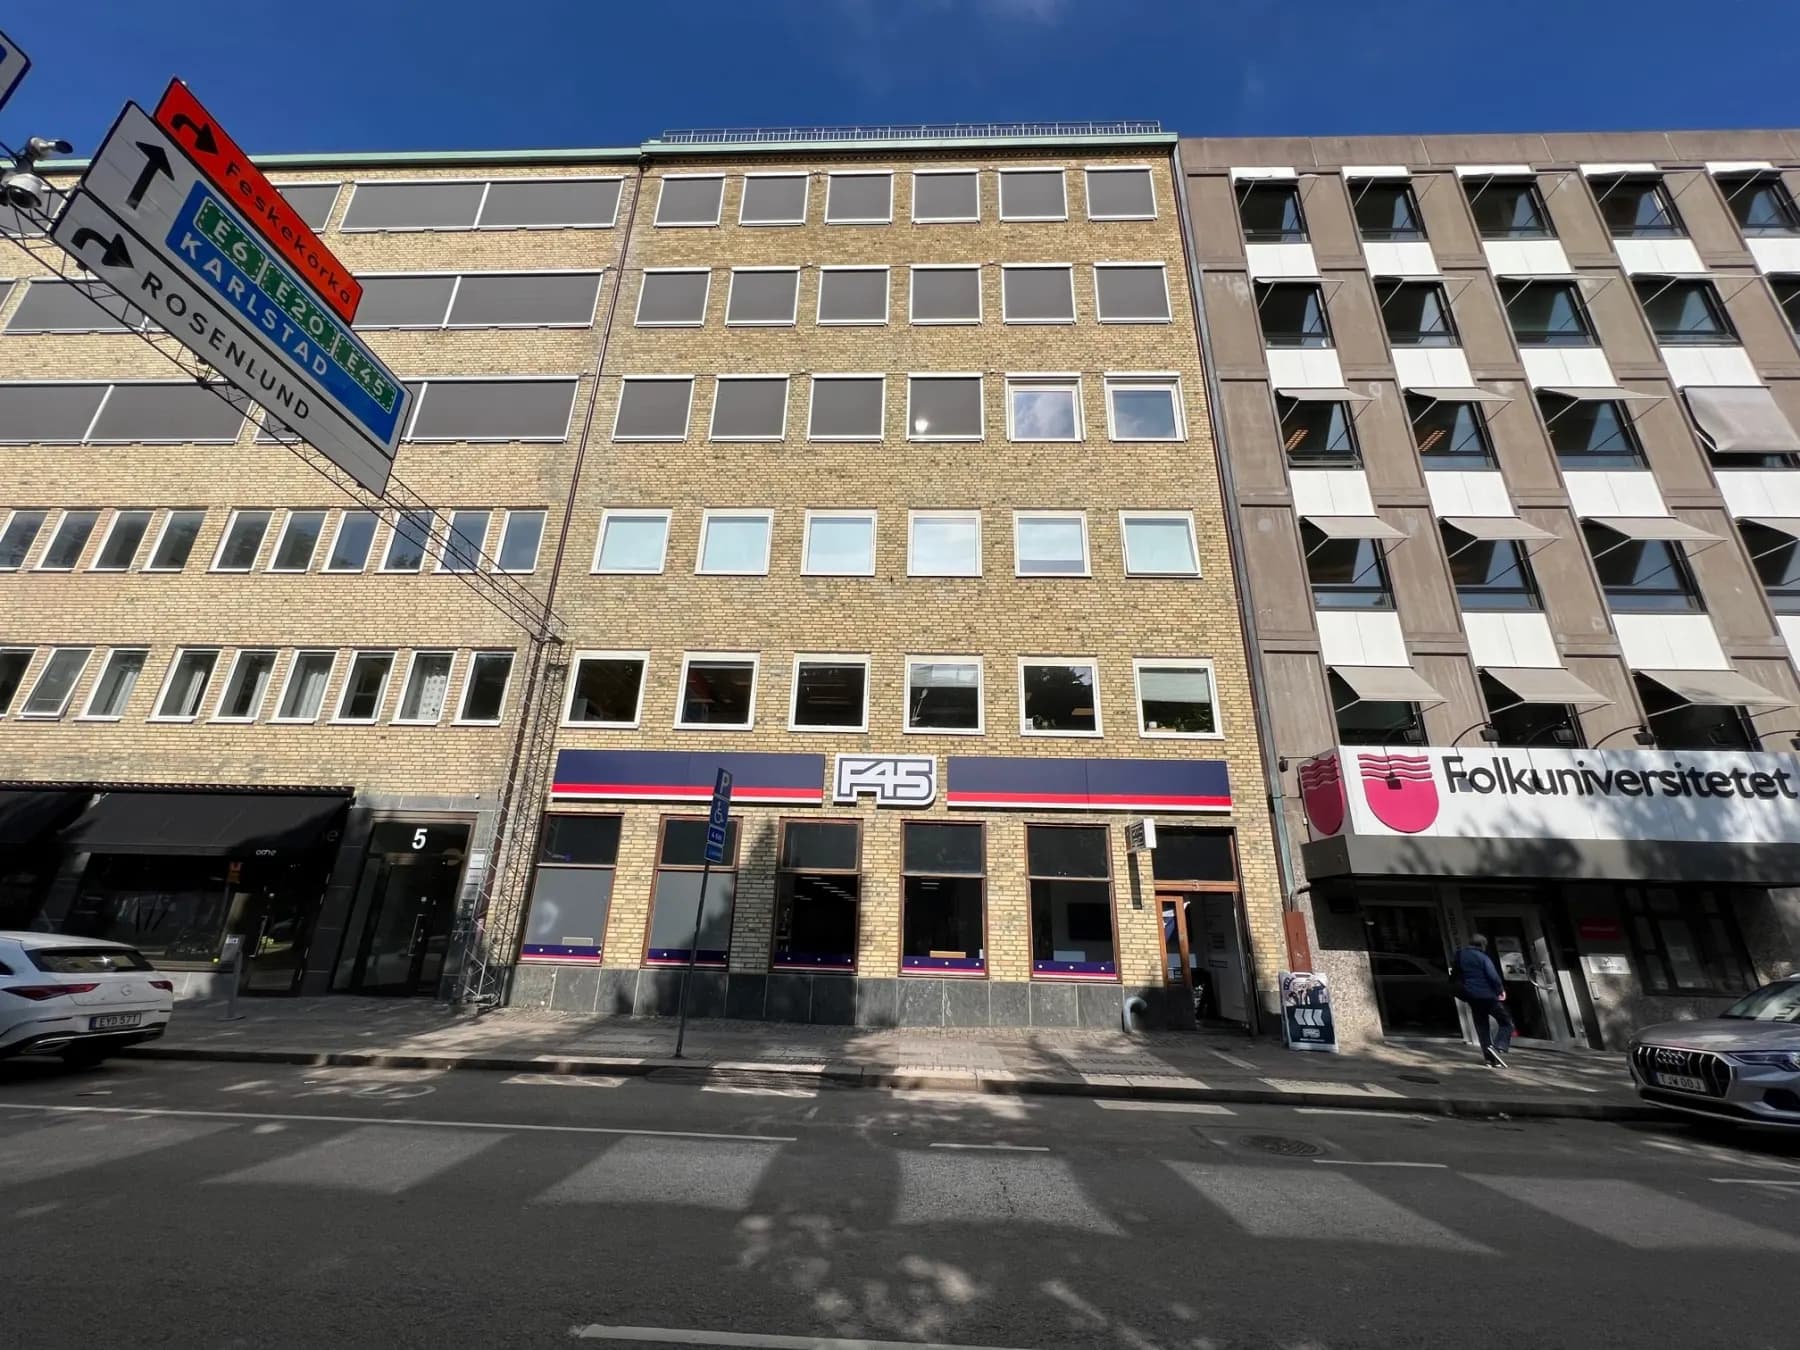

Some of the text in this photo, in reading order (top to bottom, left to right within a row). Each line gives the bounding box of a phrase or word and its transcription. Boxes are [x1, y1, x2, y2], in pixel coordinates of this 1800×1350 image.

[180, 232, 328, 376] KARLSTAD
[141, 271, 309, 420] ROSENLUND
[275, 283, 324, 335] E20
[347, 350, 384, 396] E45
[838, 757, 933, 800] F45
[1441, 756, 1798, 799] Folkuniversitetet
[412, 828, 428, 849] 5
[99, 1014, 136, 1027] EYD 571
